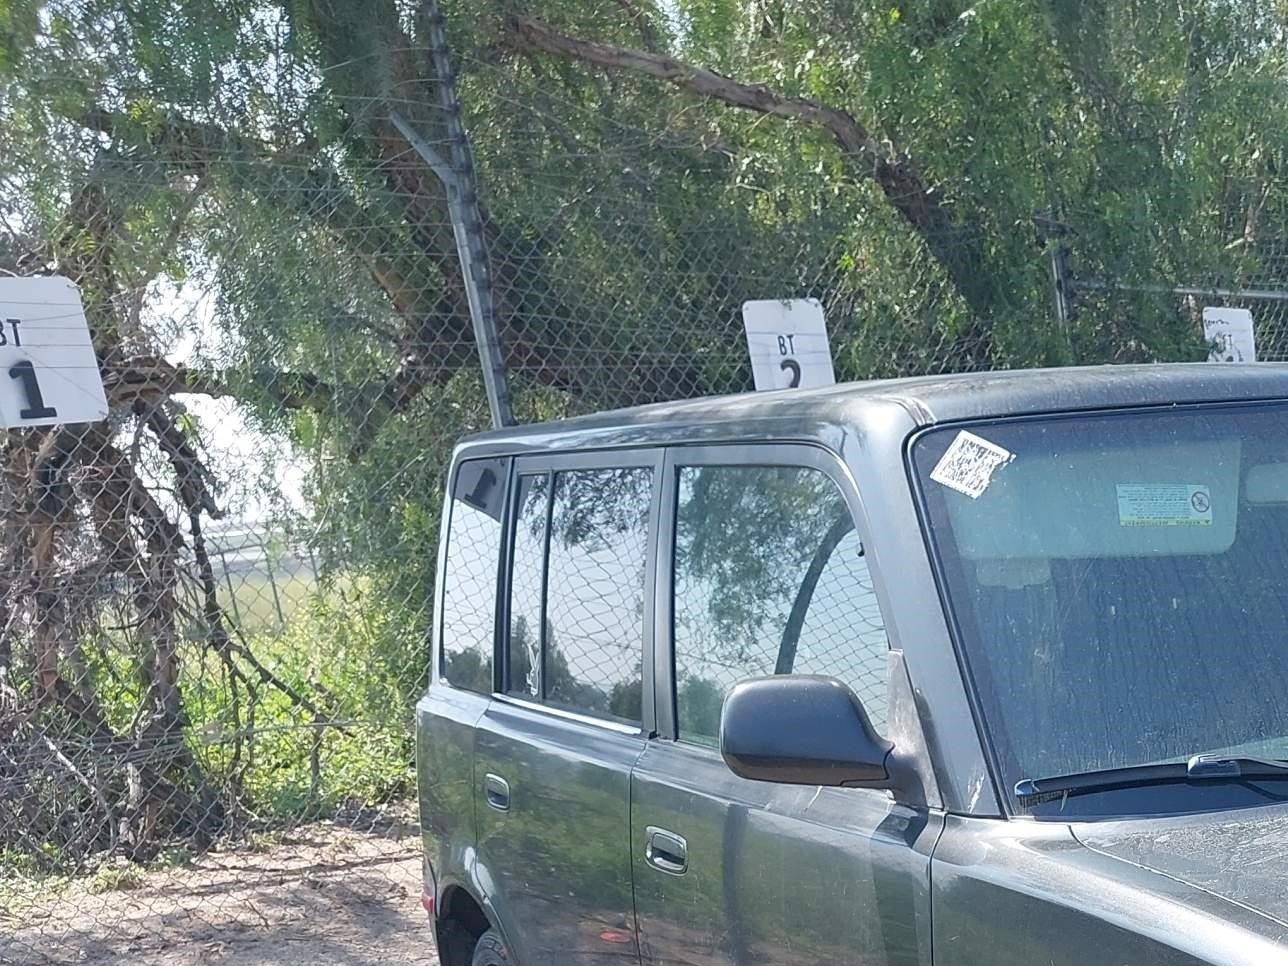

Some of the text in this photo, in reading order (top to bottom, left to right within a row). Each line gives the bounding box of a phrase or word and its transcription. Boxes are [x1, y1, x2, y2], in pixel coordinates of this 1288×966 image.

[777, 334, 795, 356] BT
[780, 358, 801, 388] 2
[8, 360, 57, 419] 1
